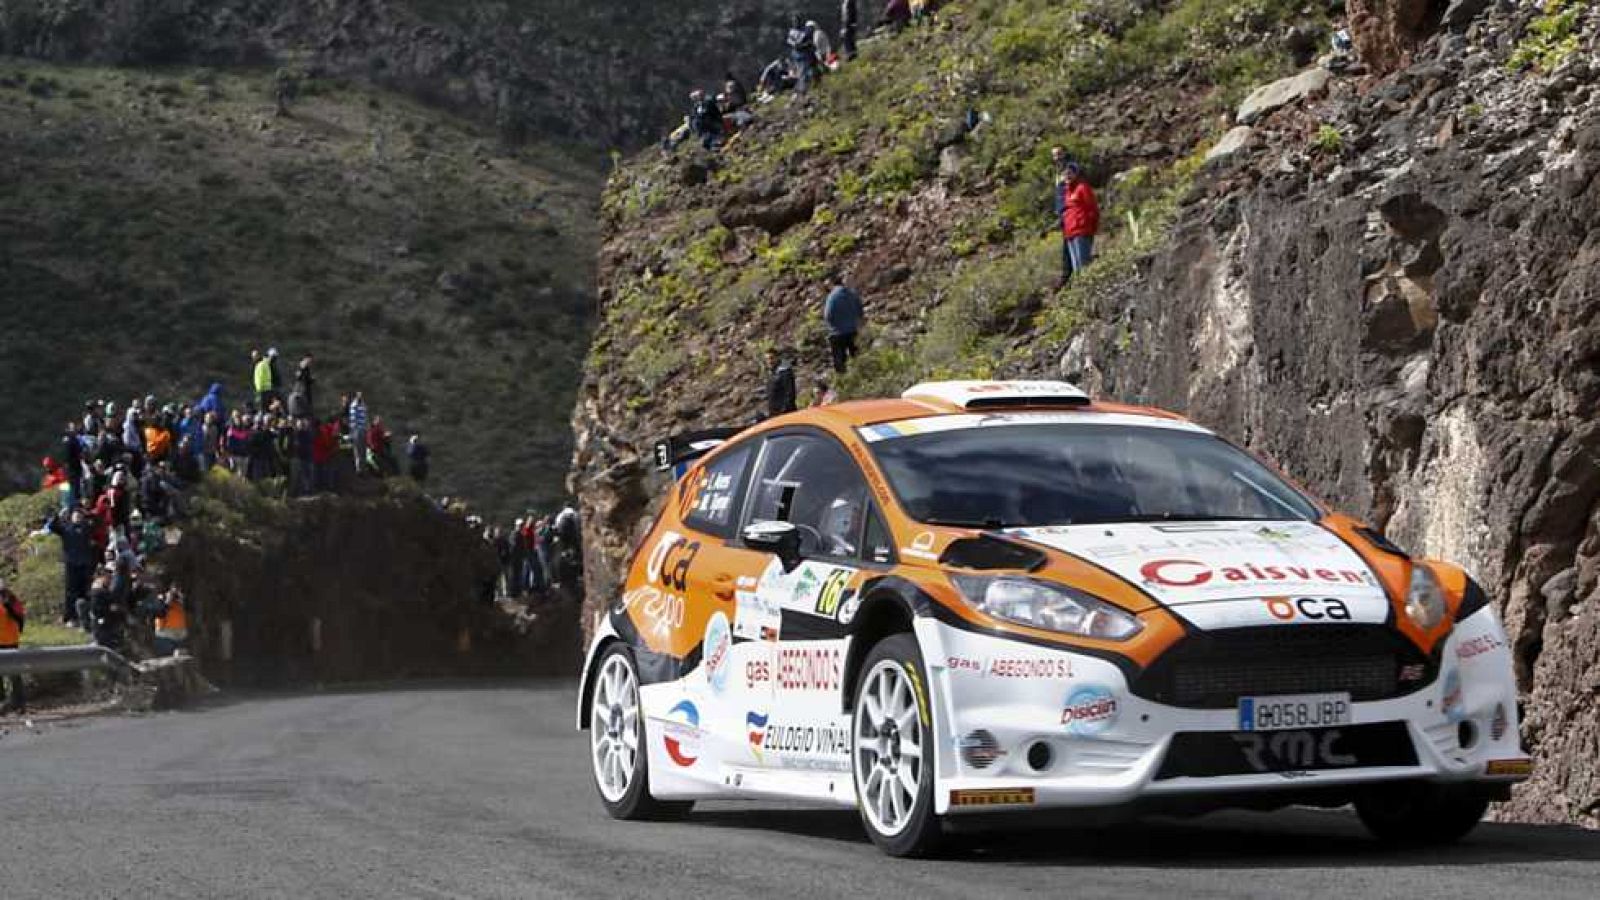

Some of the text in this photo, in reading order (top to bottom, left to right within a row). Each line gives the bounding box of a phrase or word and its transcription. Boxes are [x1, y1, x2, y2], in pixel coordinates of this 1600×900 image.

[647, 531, 701, 592] oca
[820, 568, 849, 615] 16
[1261, 595, 1350, 621] oca
[746, 661, 769, 688] gas
[947, 655, 981, 671] gas
[764, 724, 814, 752] EULOGIO
